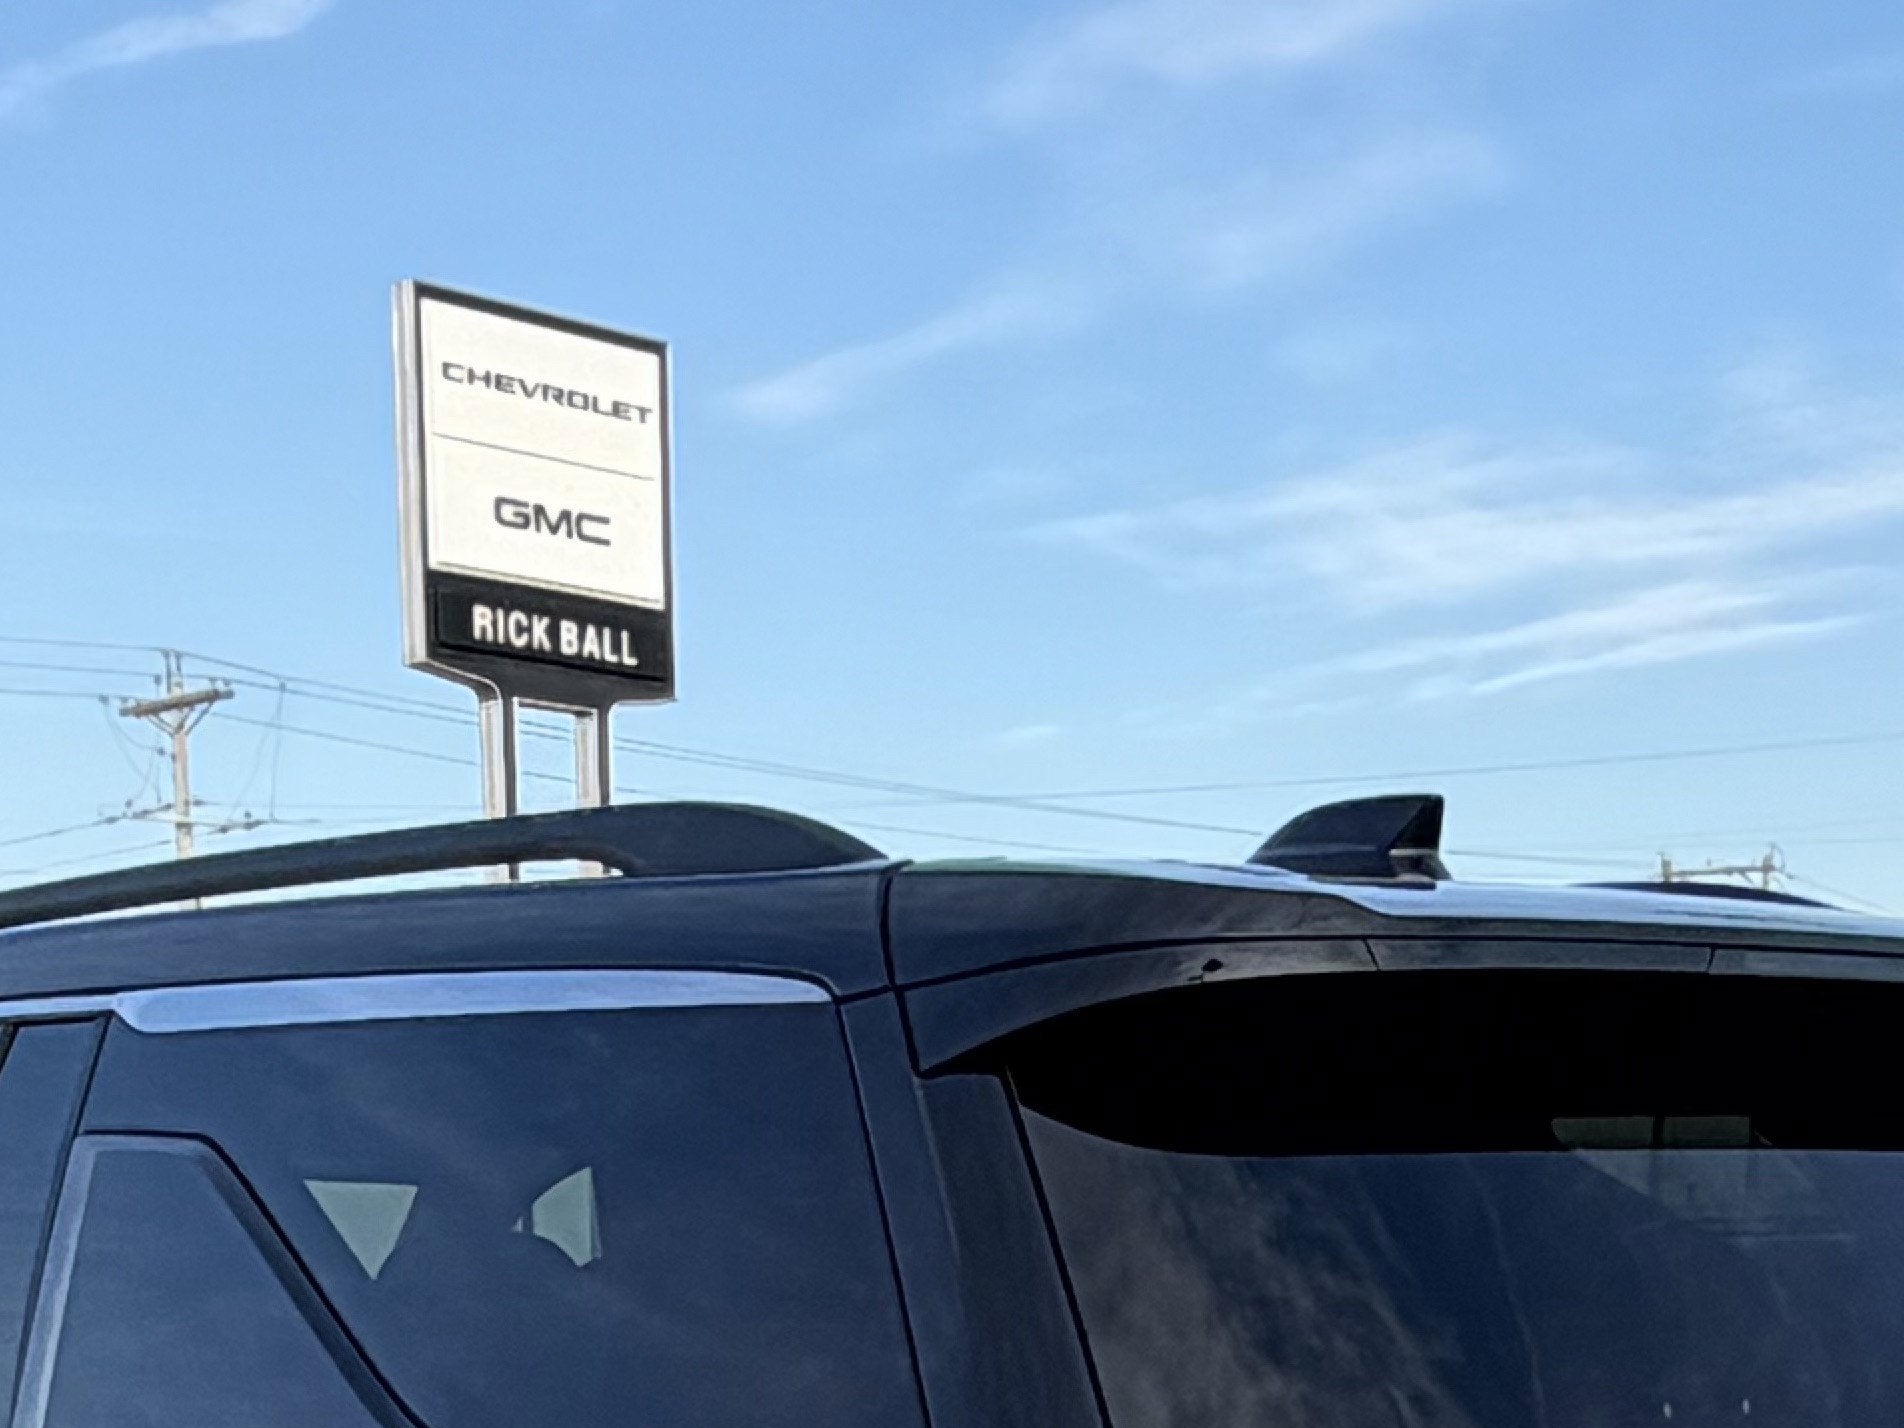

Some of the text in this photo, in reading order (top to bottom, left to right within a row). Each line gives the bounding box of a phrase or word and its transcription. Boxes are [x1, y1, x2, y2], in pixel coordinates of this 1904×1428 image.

[441, 361, 653, 424] CHEVROLET
[493, 495, 612, 547] GMC
[471, 604, 639, 667] RICK BALL
